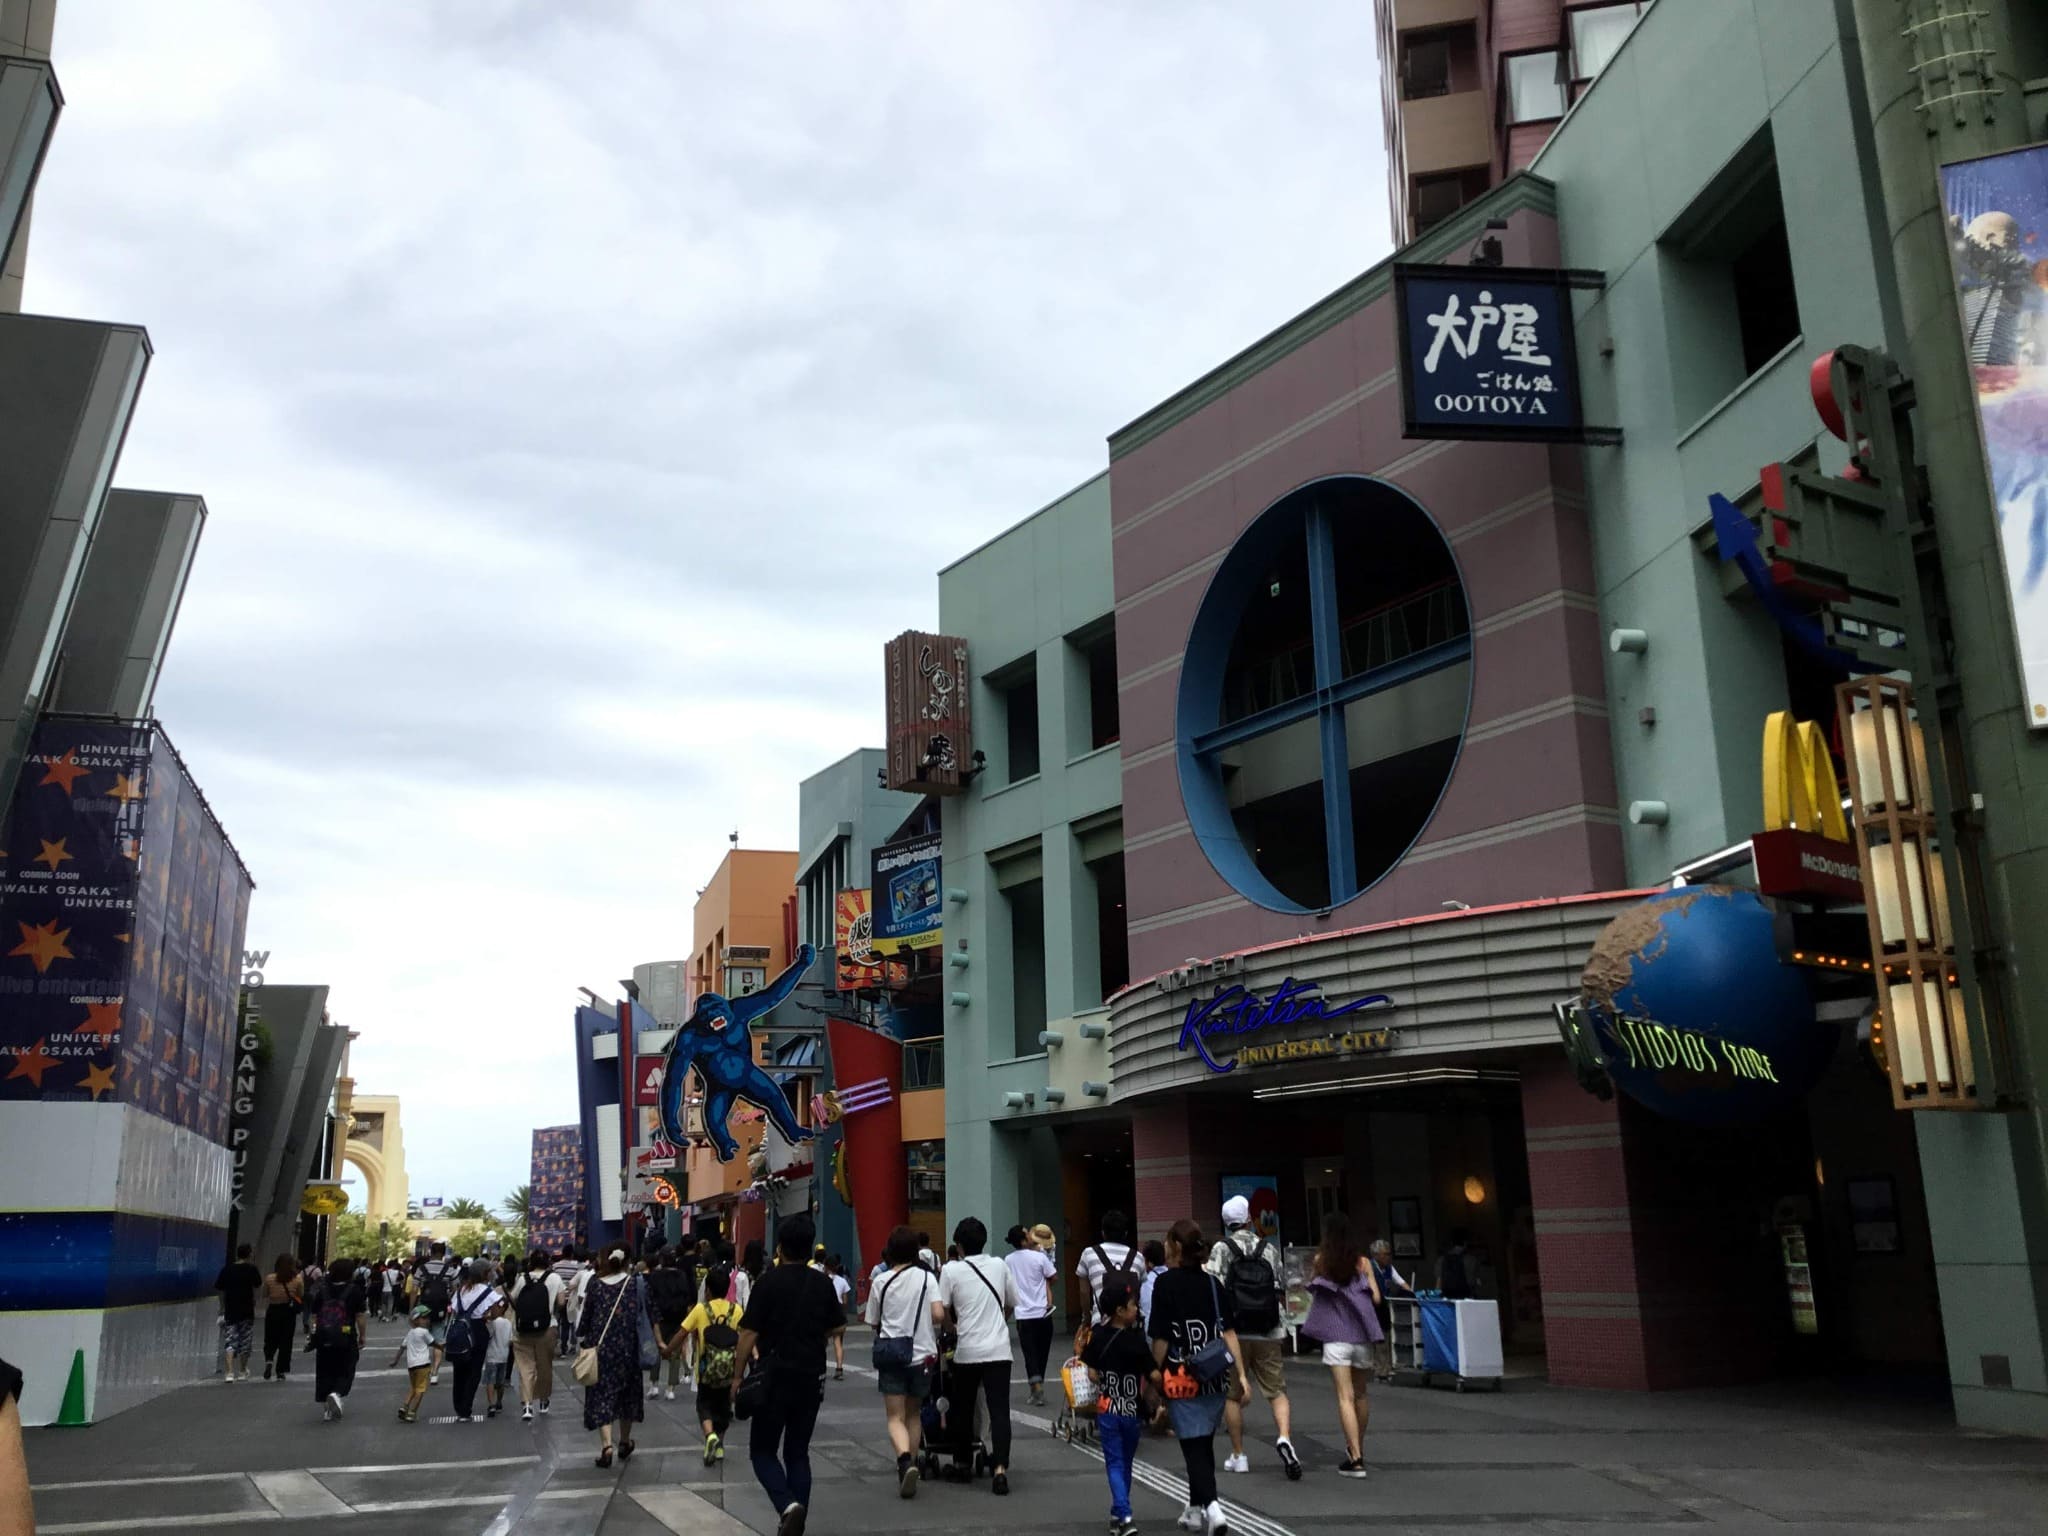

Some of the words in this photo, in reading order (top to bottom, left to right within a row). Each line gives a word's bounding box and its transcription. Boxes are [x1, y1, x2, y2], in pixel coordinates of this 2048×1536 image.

[1424, 290, 1552, 374] 大戸屋
[1434, 394, 1548, 415] OOTOYA
[233, 950, 271, 1114] WOLFGANG
[1178, 976, 1394, 1073] Kintetsu
[1236, 1039, 1335, 1067] UNIVERSAL
[1341, 1028, 1390, 1051] CITY
[1614, 1014, 1718, 1074] STUDIOS
[1720, 1039, 1780, 1084] STORE
[230, 1129, 249, 1212] PUCK
